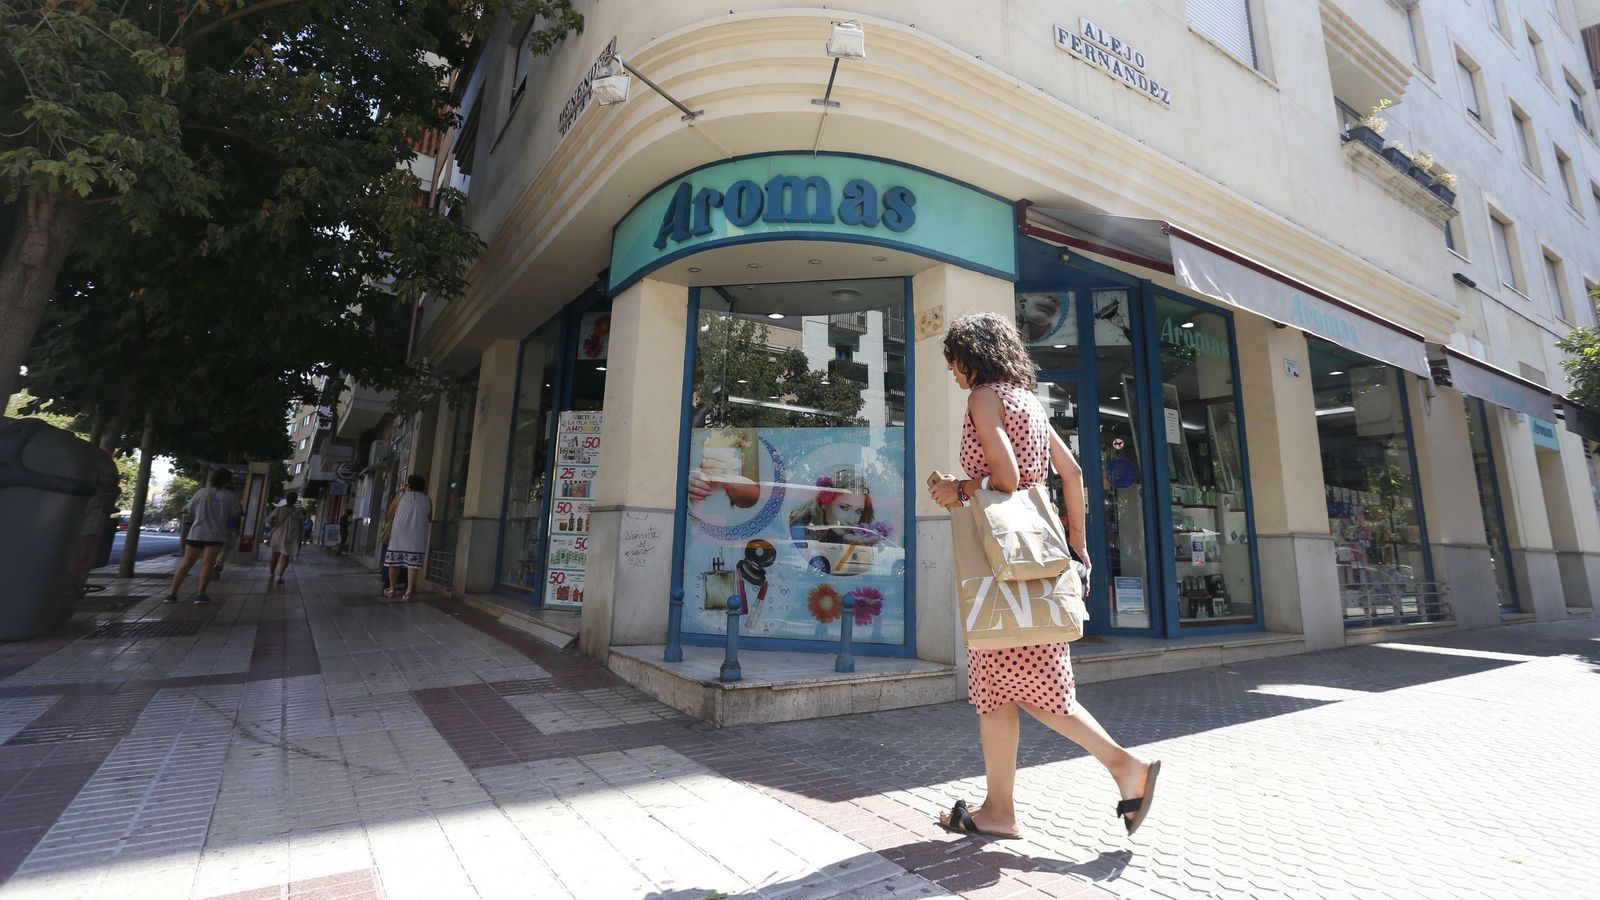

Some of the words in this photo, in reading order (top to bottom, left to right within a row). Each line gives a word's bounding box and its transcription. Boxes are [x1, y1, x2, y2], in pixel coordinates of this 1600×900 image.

[1056, 26, 1171, 106] FERNANDEZ
[1084, 22, 1145, 68] ALEJO
[652, 173, 917, 251] Aromas
[1160, 316, 1230, 359] Aromas
